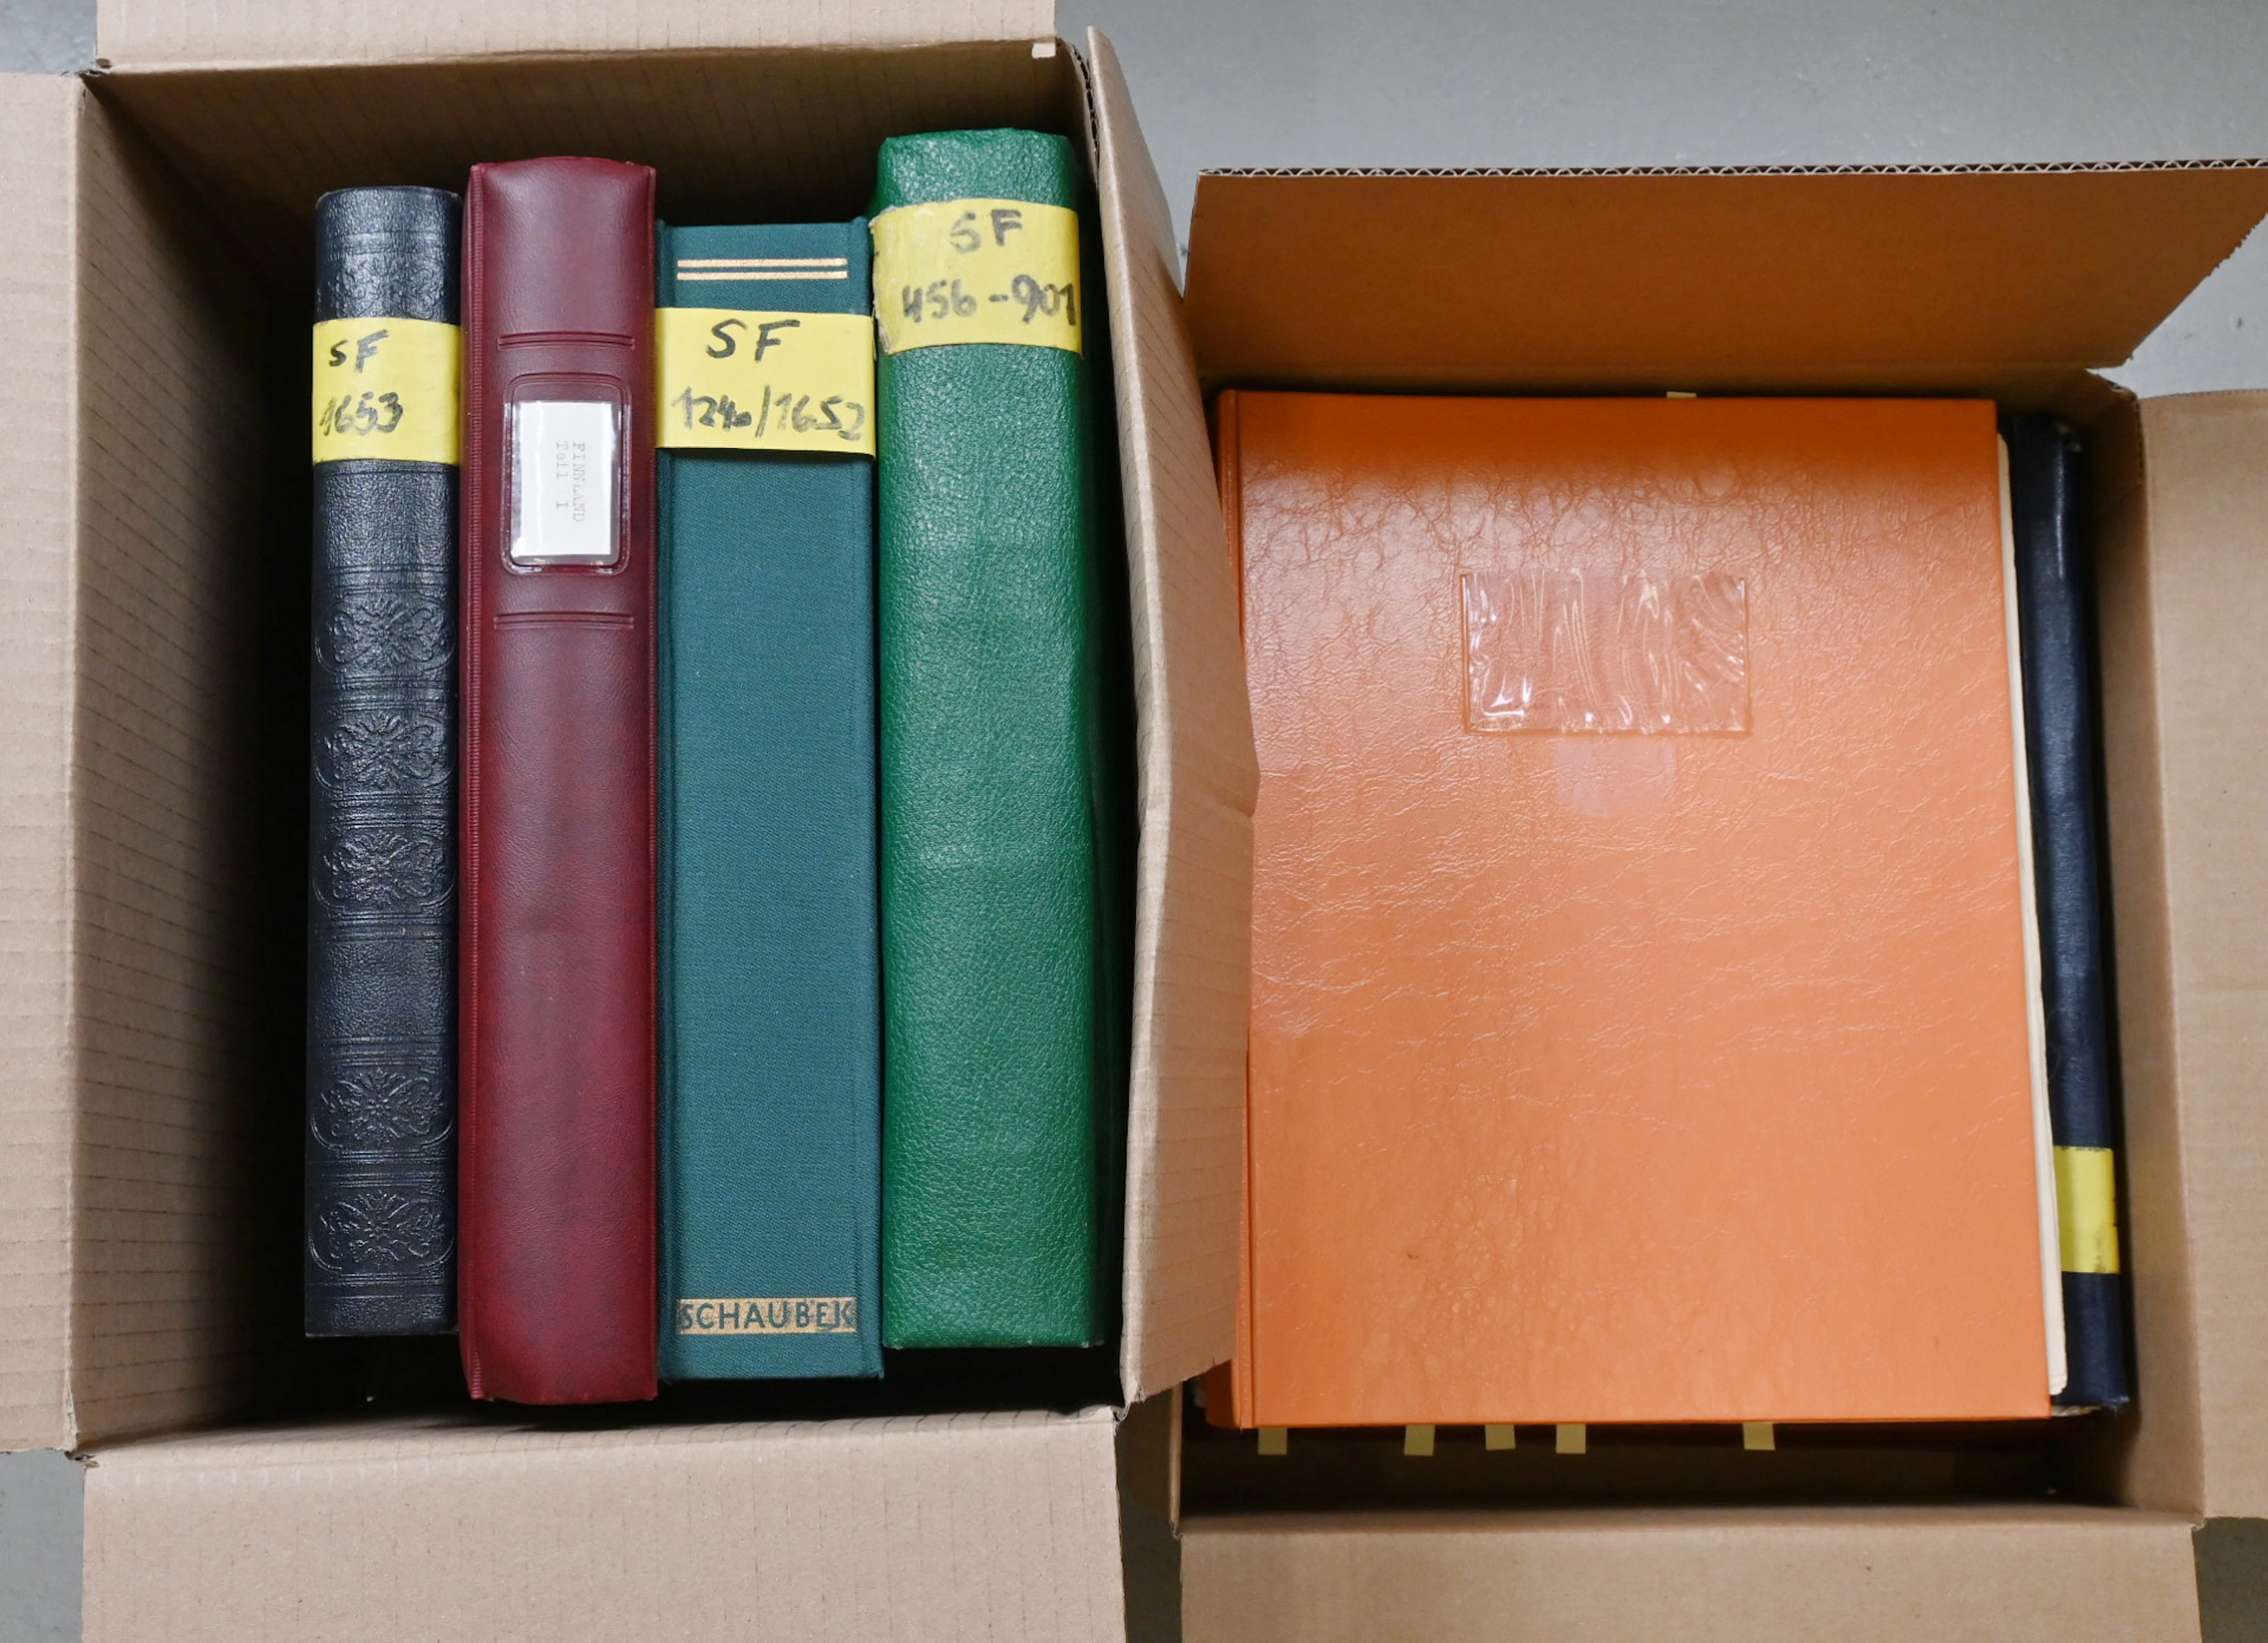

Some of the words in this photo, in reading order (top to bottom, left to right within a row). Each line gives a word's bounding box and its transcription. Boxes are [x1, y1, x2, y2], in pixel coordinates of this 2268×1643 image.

[950, 208, 1023, 254] SF
[328, 328, 389, 373] SF
[705, 318, 801, 363] SF
[319, 392, 403, 436] 1653
[556, 440, 569, 480] Teil
[572, 442, 586, 522] FINNLAND
[678, 1300, 856, 1329] SCHAUBEK
